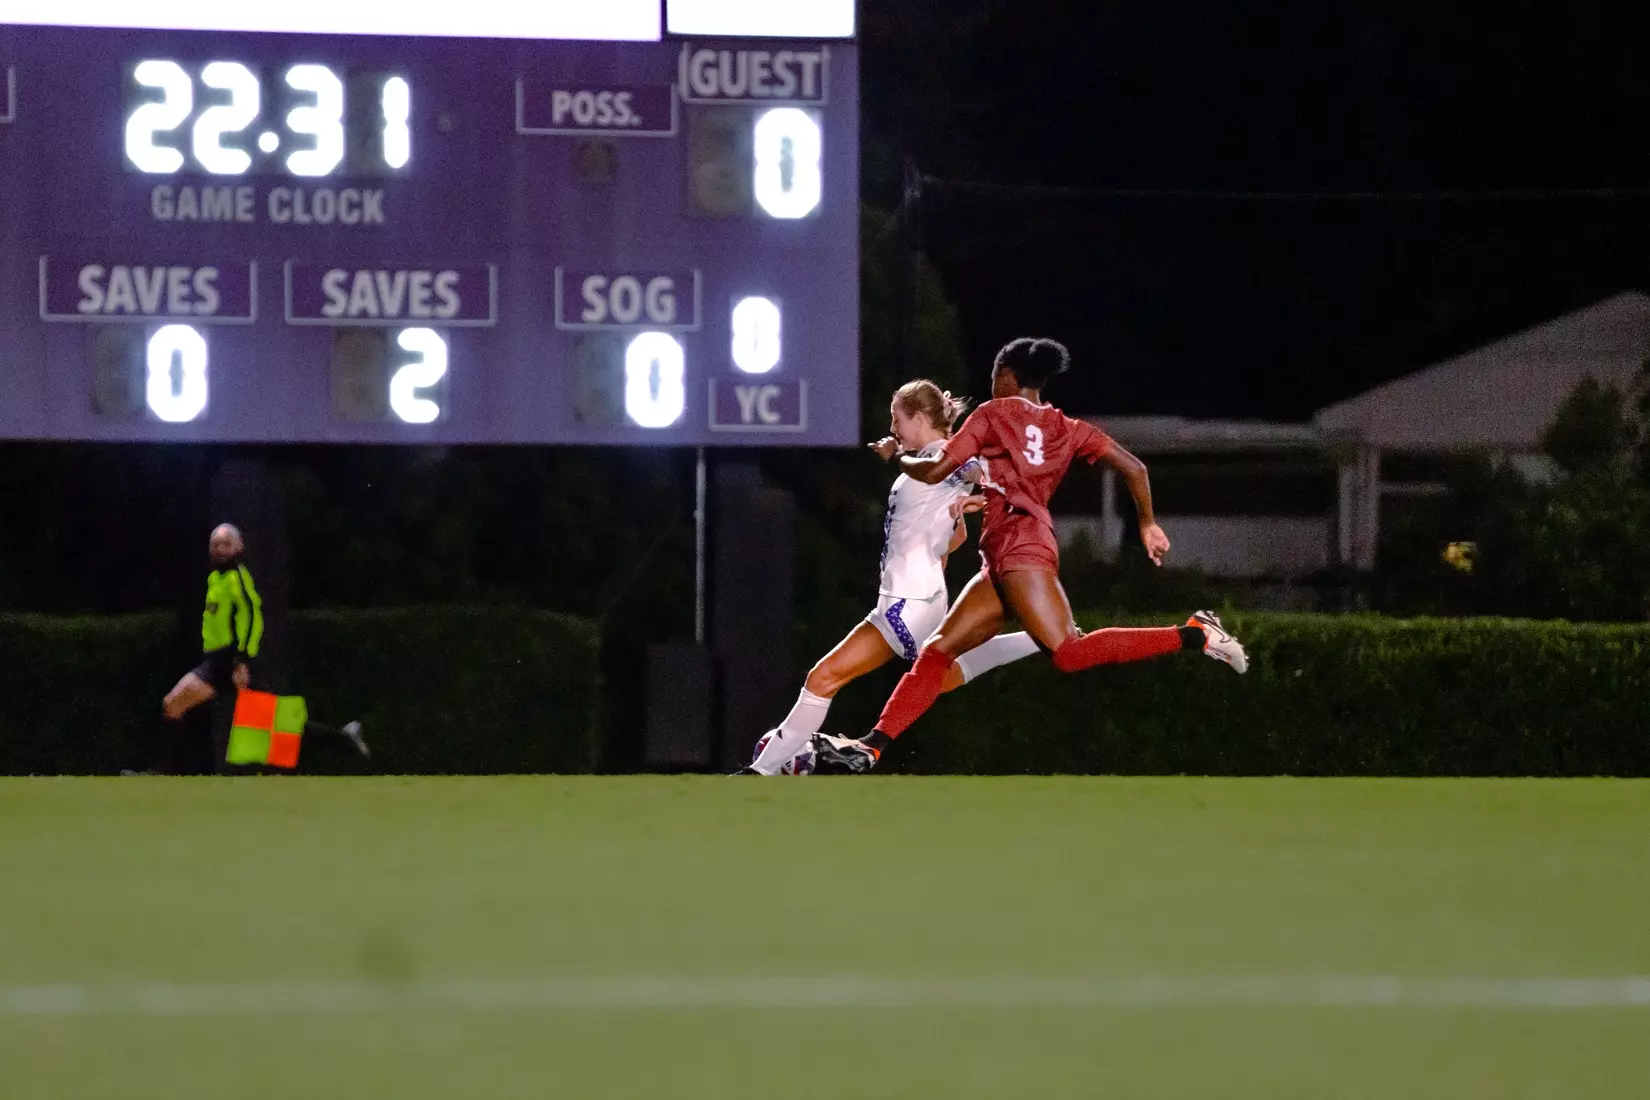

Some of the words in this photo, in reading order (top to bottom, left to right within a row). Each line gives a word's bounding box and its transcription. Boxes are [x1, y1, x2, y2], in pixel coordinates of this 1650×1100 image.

[690, 49, 822, 97] GUEST
[551, 91, 643, 126] POSS.
[753, 107, 821, 219] 0
[151, 186, 255, 221] GAME
[268, 187, 386, 224] CLOCK
[77, 264, 221, 317] SAVES
[321, 268, 462, 319] SAVES
[580, 274, 677, 324] SOG
[146, 324, 208, 422] 0
[389, 327, 448, 424] 2
[624, 331, 685, 428] 0
[735, 385, 781, 424] YC
[1023, 425, 1045, 465] 3
